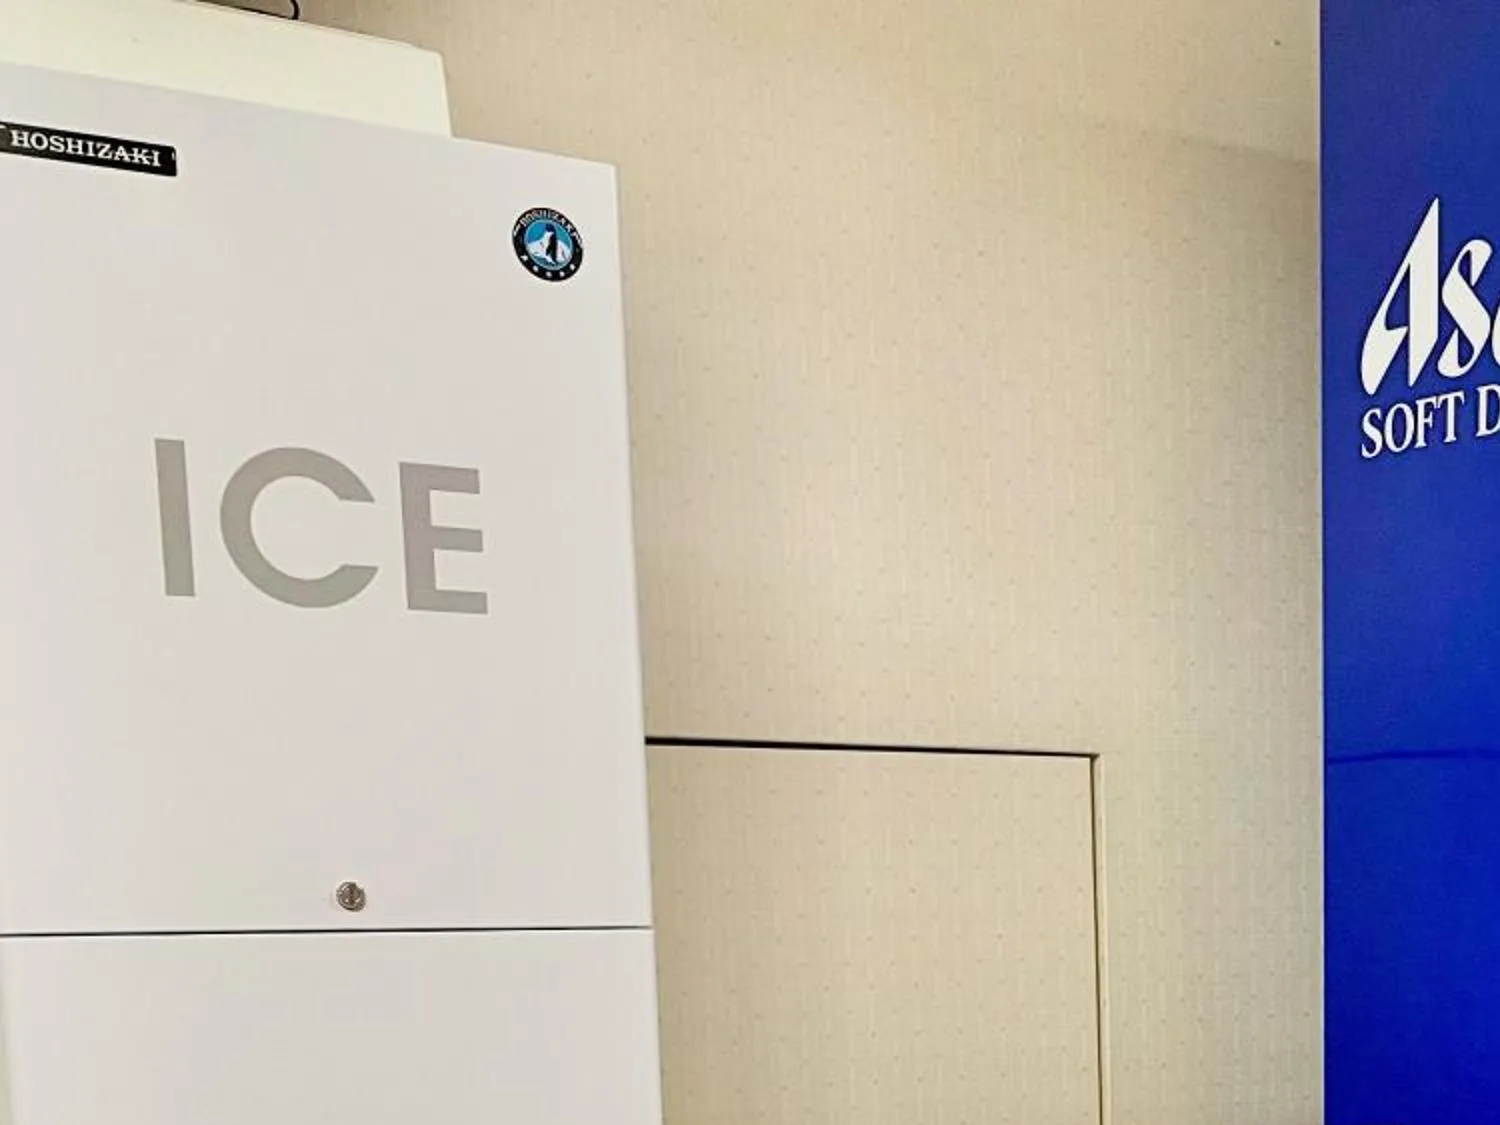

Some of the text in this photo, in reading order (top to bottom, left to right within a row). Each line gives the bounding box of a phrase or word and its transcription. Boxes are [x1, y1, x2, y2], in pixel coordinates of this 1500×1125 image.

[11, 129, 162, 167] HOSHIZAKI
[1361, 390, 1465, 459] SOFT
[154, 437, 489, 615] ICE
